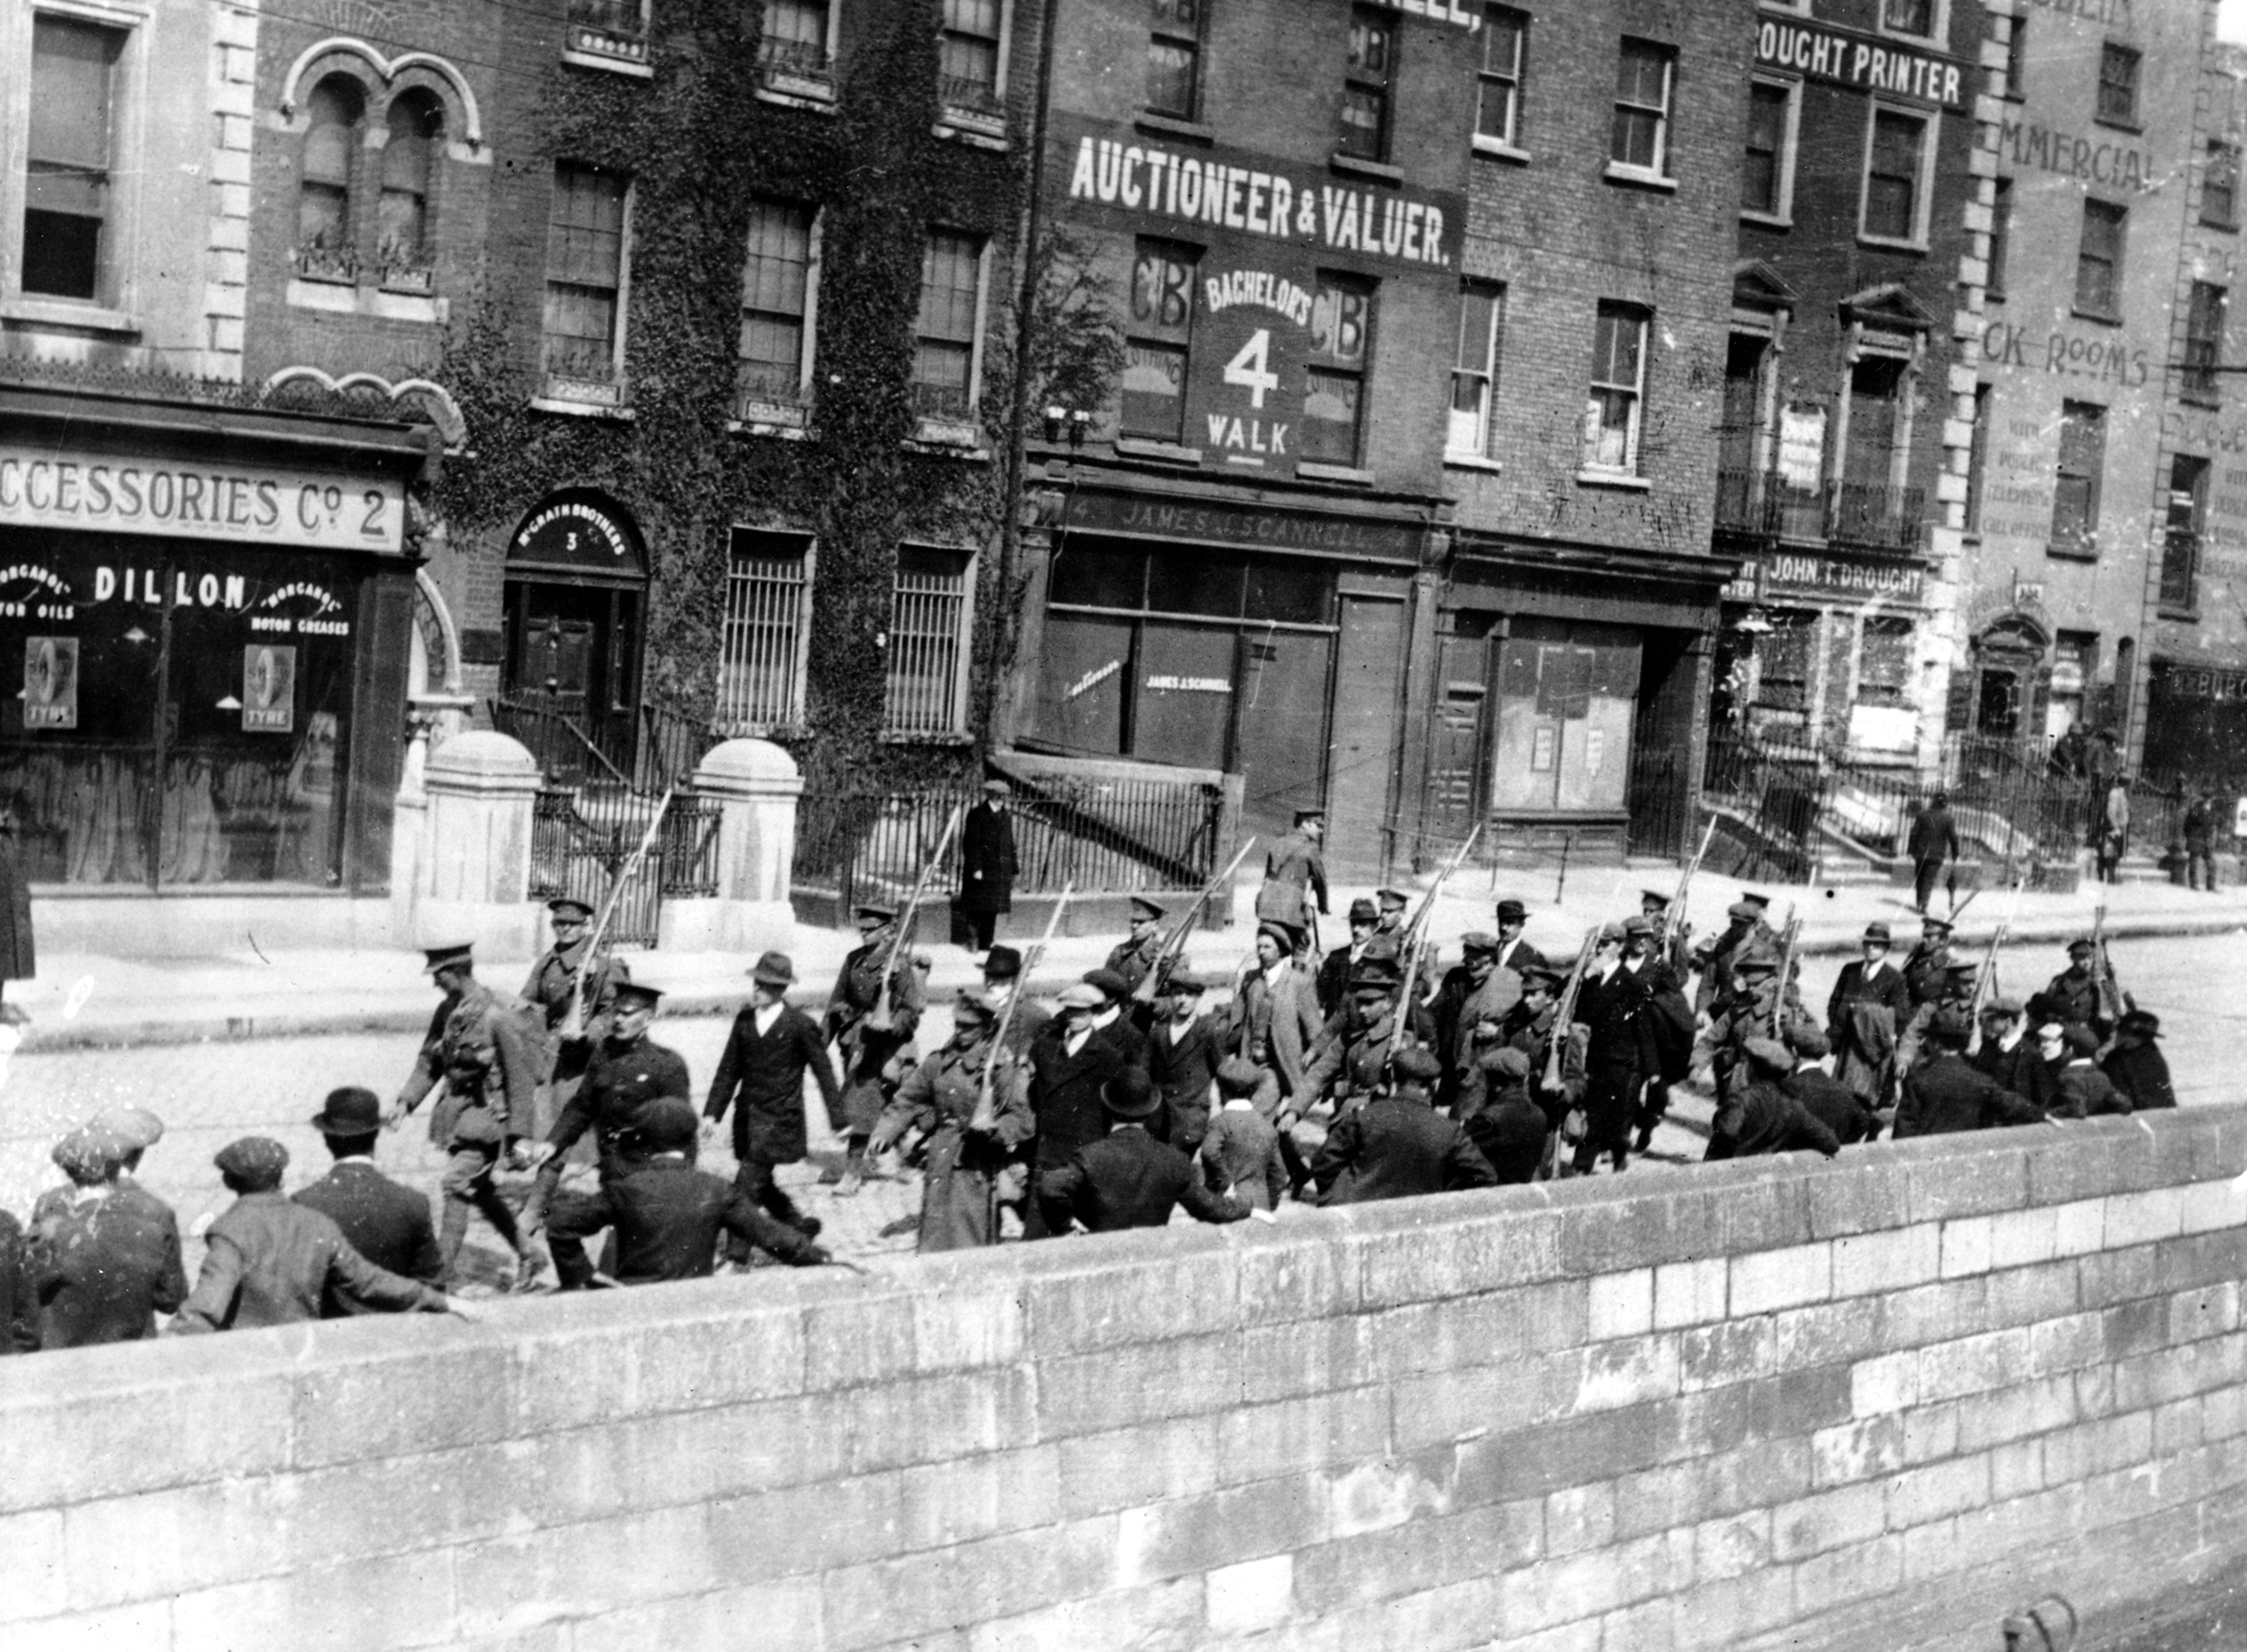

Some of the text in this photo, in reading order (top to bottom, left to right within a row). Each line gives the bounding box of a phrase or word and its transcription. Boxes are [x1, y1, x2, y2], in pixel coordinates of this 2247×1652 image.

[1755, 22, 1961, 104] OUGHT PRINTER
[1070, 136, 1293, 237] AUCTIONEER
[1297, 189, 1316, 234] &
[1223, 329, 1279, 408] 4
[2045, 333, 2147, 387] ROOMS
[1207, 413, 1288, 454] WALK
[0, 459, 279, 526] CCESSORIES
[360, 490, 385, 535] 2
[566, 532, 577, 551] 3
[571, 503, 625, 556] BROTHERS
[37, 603, 74, 621] OILS
[94, 566, 245, 610] DILLON
[251, 616, 349, 636] MOTOR GREASES
